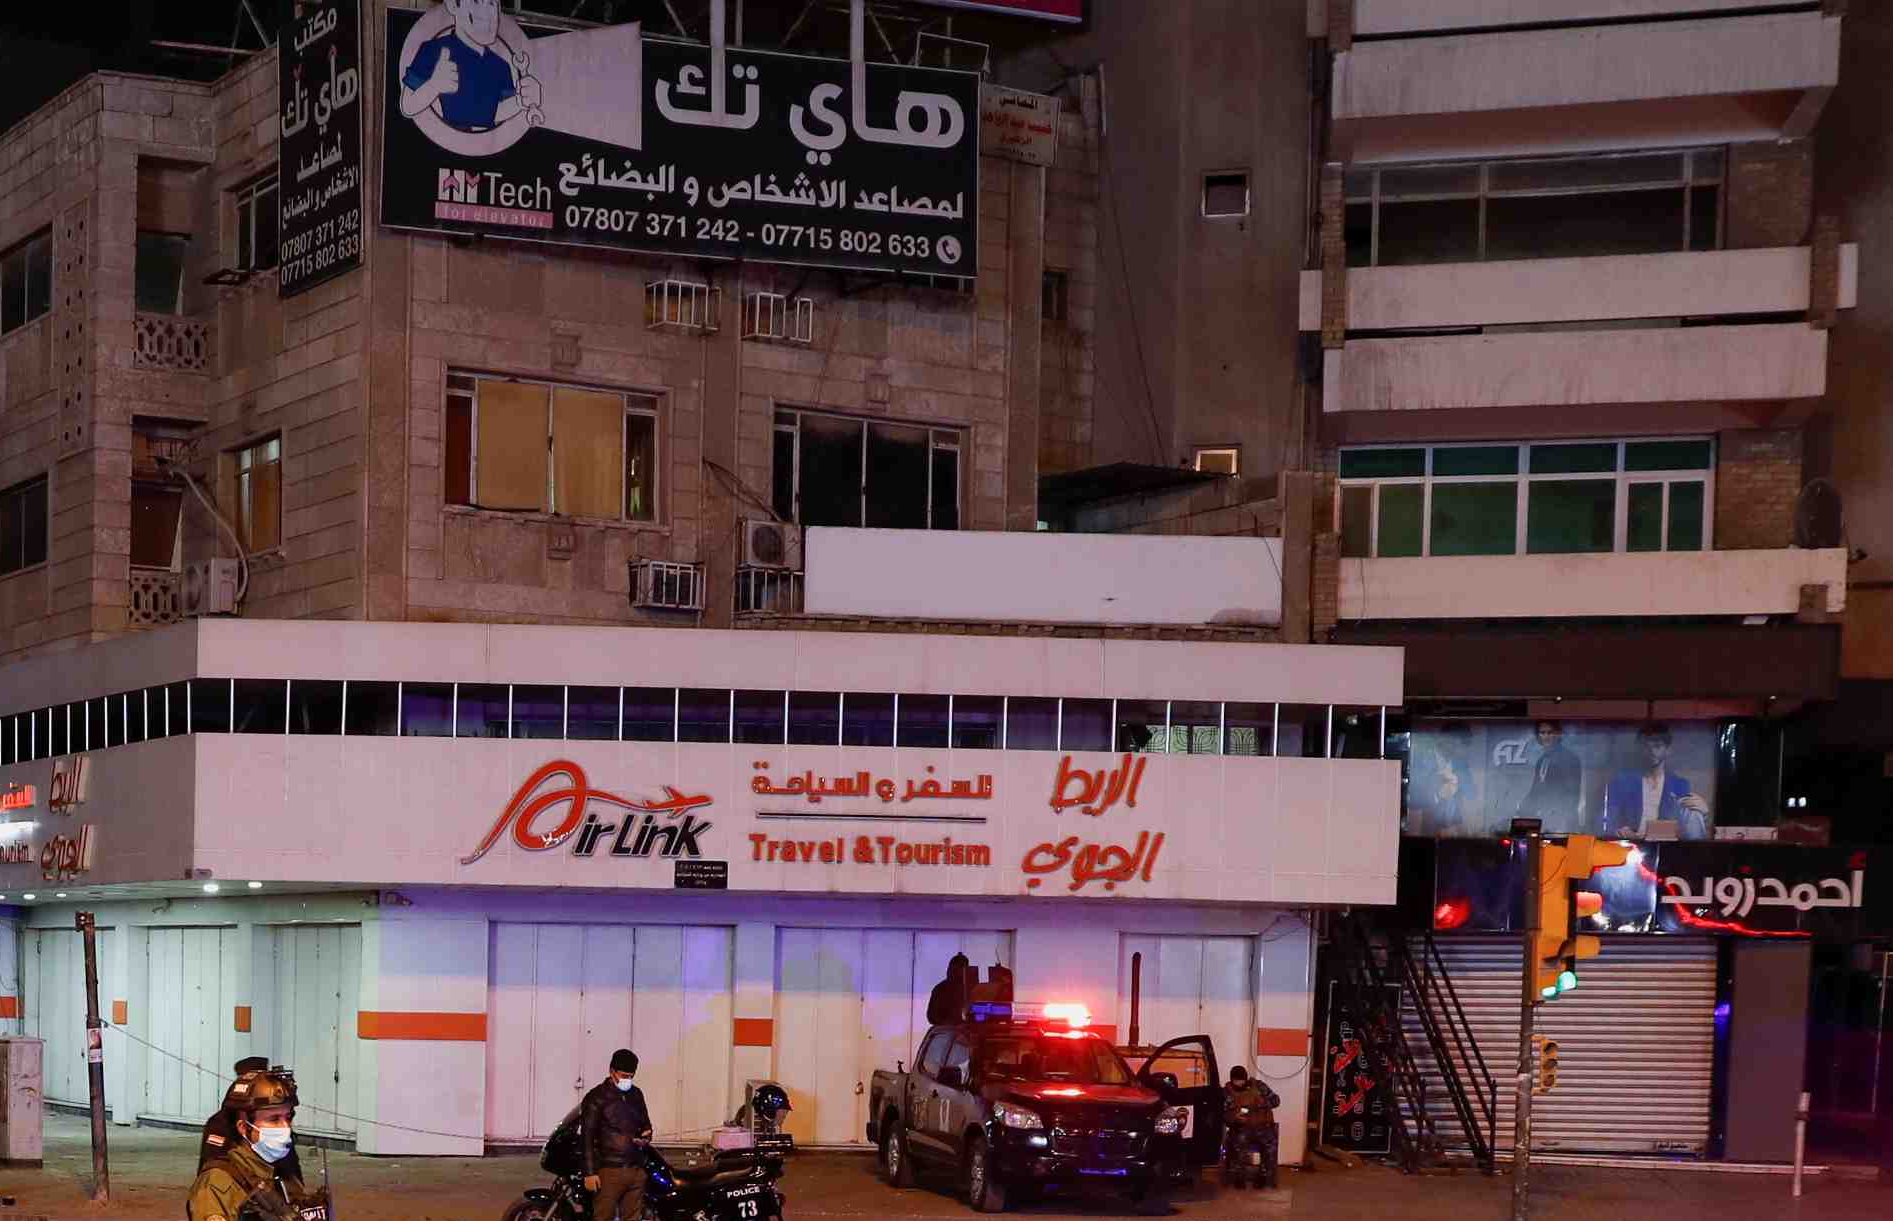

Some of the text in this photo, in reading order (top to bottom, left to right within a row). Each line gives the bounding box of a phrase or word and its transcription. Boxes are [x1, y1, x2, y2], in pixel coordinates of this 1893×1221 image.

[294, 8, 337, 56] مكتب
[656, 15, 965, 165] هاي تك
[483, 171, 552, 210] Tech
[558, 153, 675, 198] البضائع
[707, 171, 846, 208] الاشخاص
[854, 184, 963, 219] لمصاعد
[281, 208, 358, 262] 07807 371 242
[565, 204, 639, 233] 07807
[646, 213, 687, 238] 371
[695, 218, 739, 242] 242
[761, 223, 833, 249] 07715
[839, 229, 882, 253] 802
[888, 234, 930, 258] 633
[281, 233, 358, 285] 07715 802 633
[749, 833, 844, 864] Travel
[726, 1186, 760, 1198] POLICE
[738, 1200, 758, 1218] 73
